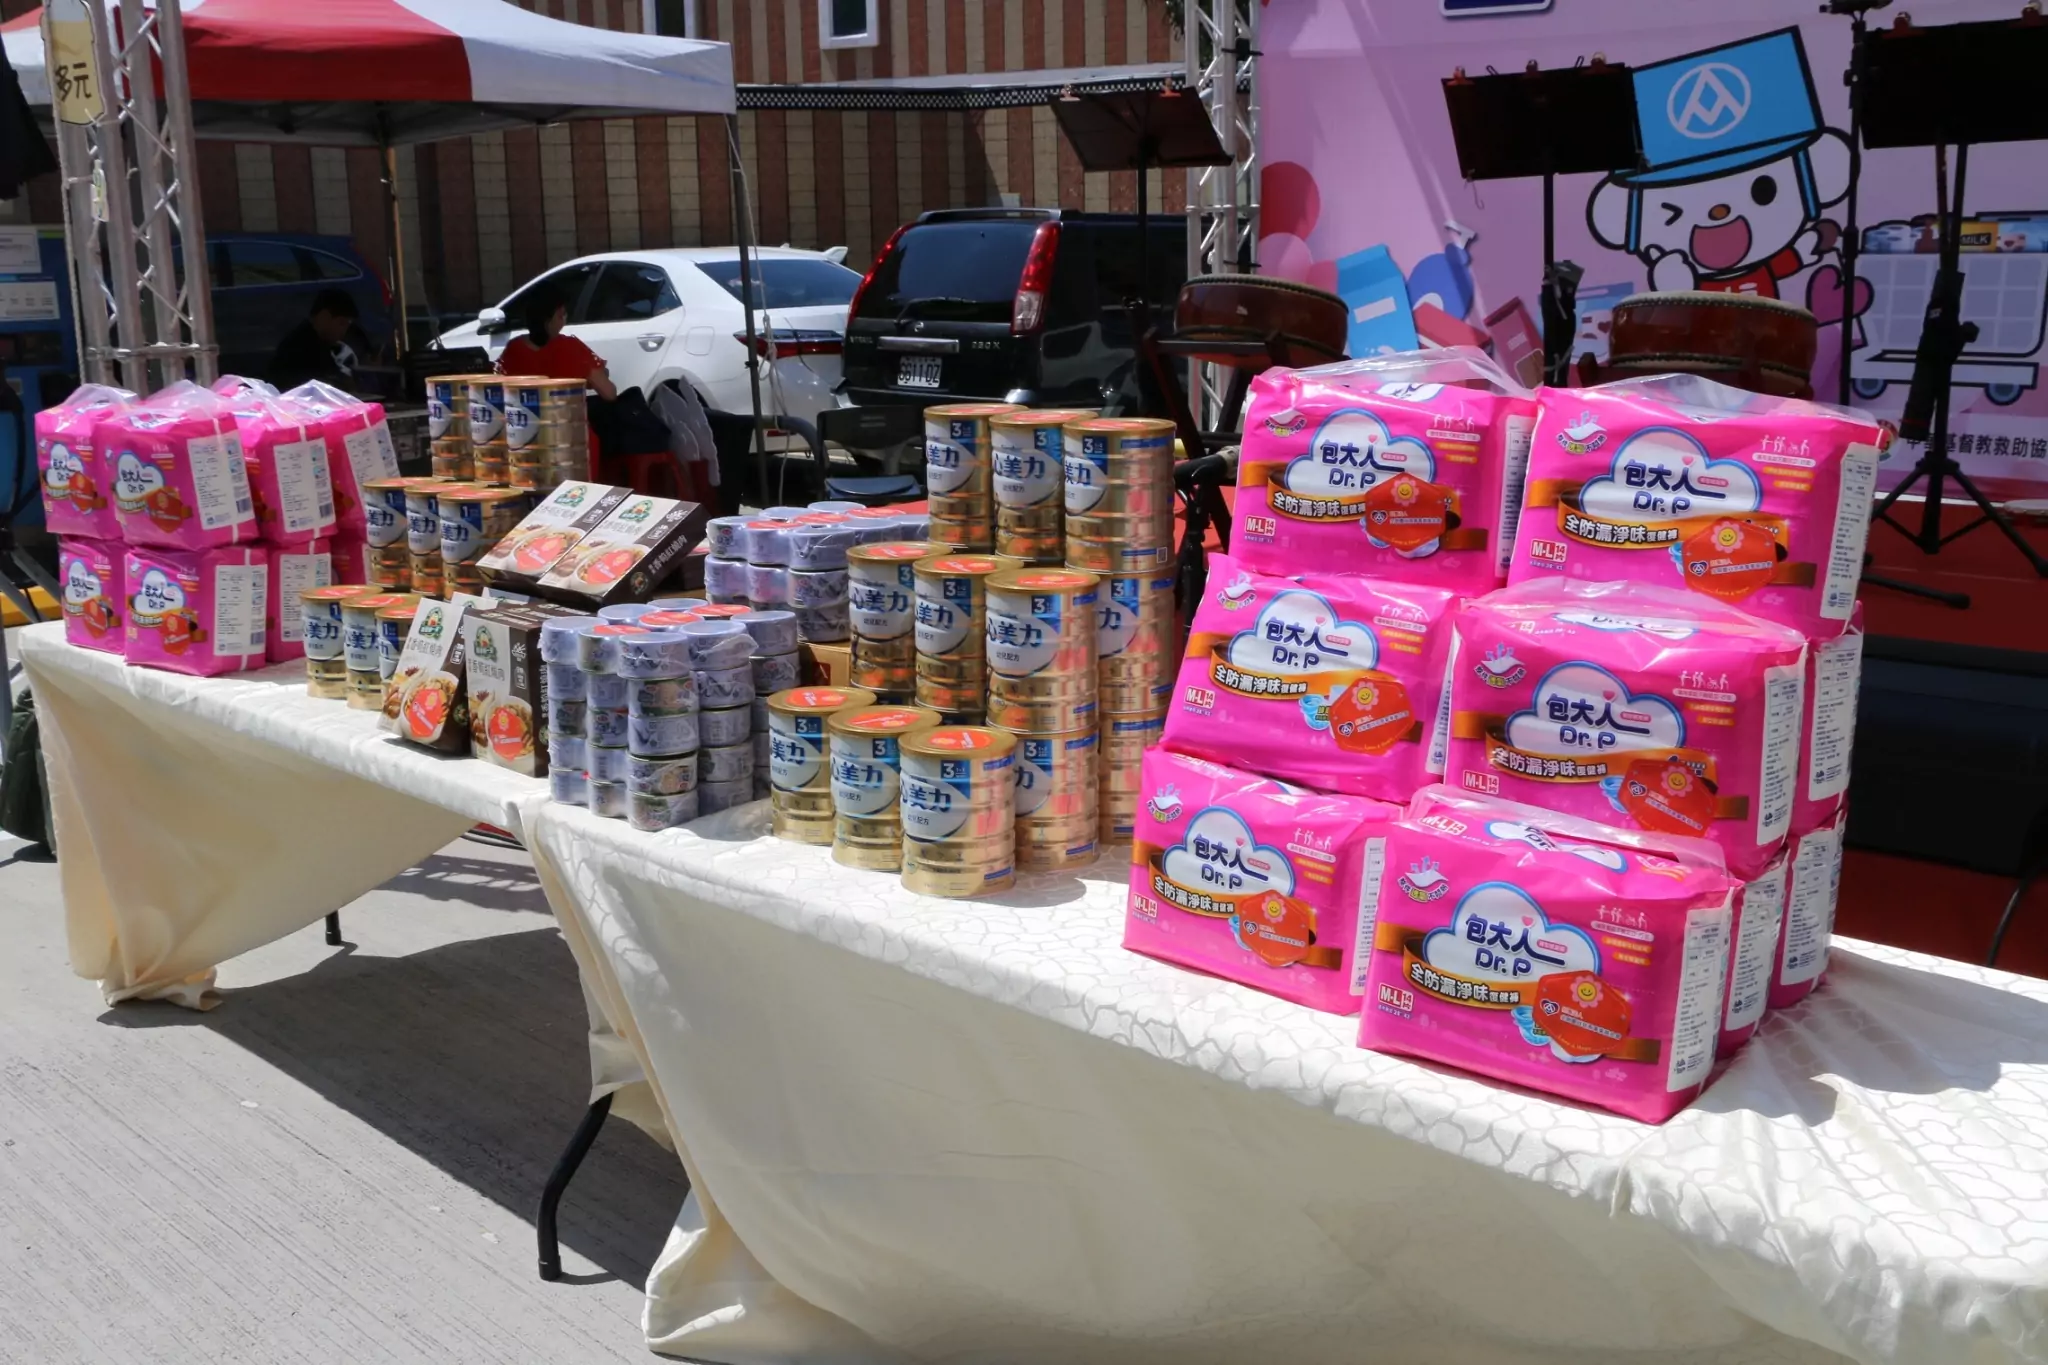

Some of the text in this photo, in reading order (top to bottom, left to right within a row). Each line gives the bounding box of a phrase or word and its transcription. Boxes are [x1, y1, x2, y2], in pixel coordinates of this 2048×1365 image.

[56, 62, 91, 102] 多元
[1961, 235, 1989, 246] MILK
[952, 423, 962, 437] 3
[1036, 431, 1047, 446] 3
[1084, 438, 1093, 453] 3
[1320, 437, 1406, 473] 包大人
[1623, 458, 1726, 499] 包大人
[901, 567, 912, 582] 3
[945, 581, 956, 596] 3
[1113, 583, 1124, 597] 3
[851, 589, 908, 613] 心美力
[1034, 598, 1045, 613] 3
[915, 603, 953, 630] 美力
[304, 622, 339, 639] 美力
[1266, 616, 1348, 657] 包大人
[1546, 693, 1650, 736] 包大人
[797, 718, 807, 733] 3
[874, 741, 885, 755] 3
[1026, 742, 1037, 757] 3
[943, 763, 954, 778] 3
[1193, 836, 1269, 881] 包大人
[1466, 913, 1566, 966] 包大人
